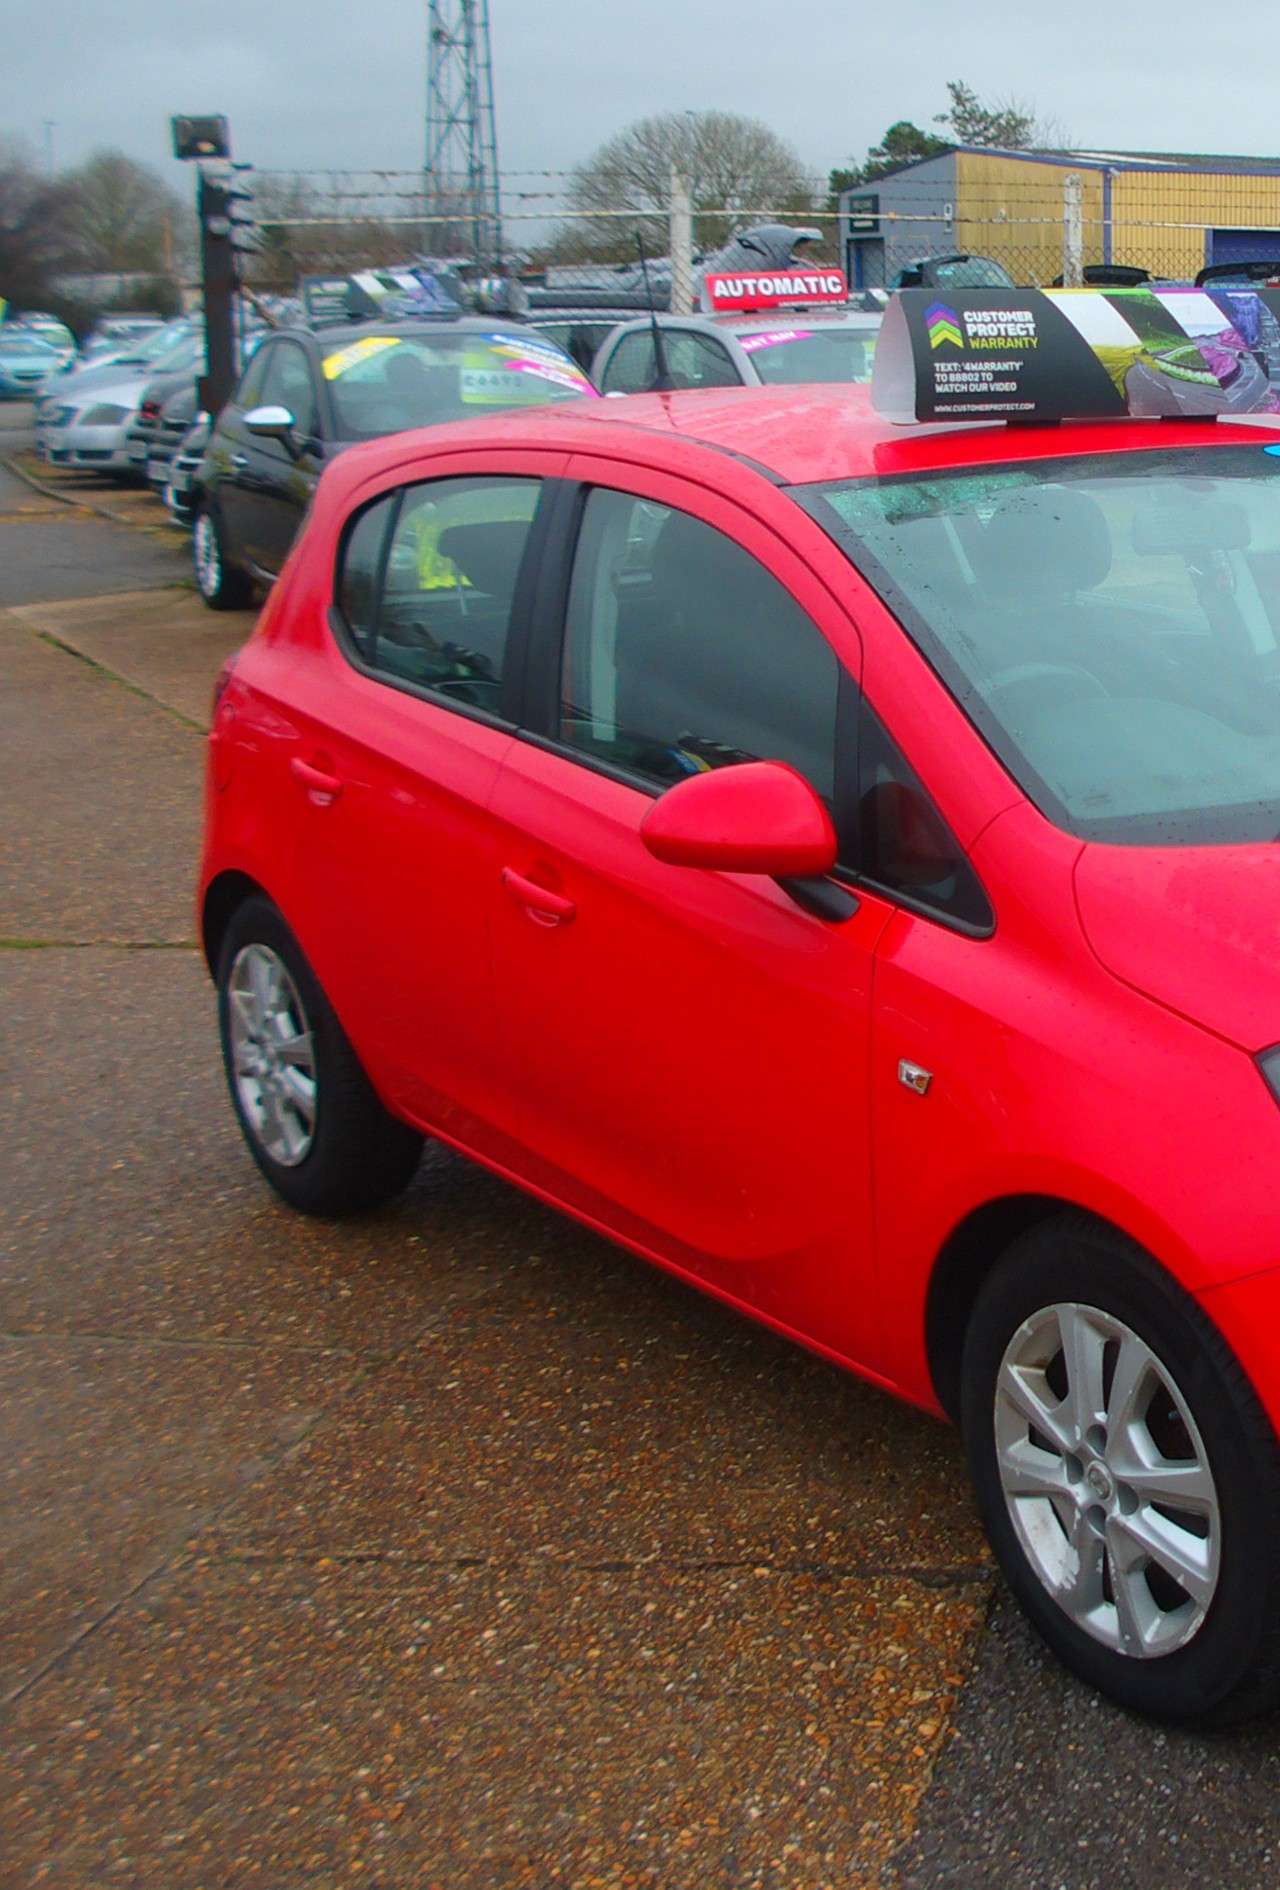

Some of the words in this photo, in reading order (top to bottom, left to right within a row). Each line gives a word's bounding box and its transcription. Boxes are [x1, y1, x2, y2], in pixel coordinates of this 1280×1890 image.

[714, 276, 843, 297] AUTOMATIC
[963, 311, 1034, 323] CUSTOMER
[966, 323, 1036, 337] PROTECT
[969, 337, 1038, 349] WARRANTY
[934, 363, 961, 372] TEXT:
[935, 373, 948, 382] TO
[981, 372, 993, 382] TO
[935, 383, 968, 393] WATCH
[969, 383, 989, 392] OUR
[990, 382, 1018, 392] VIDEO
